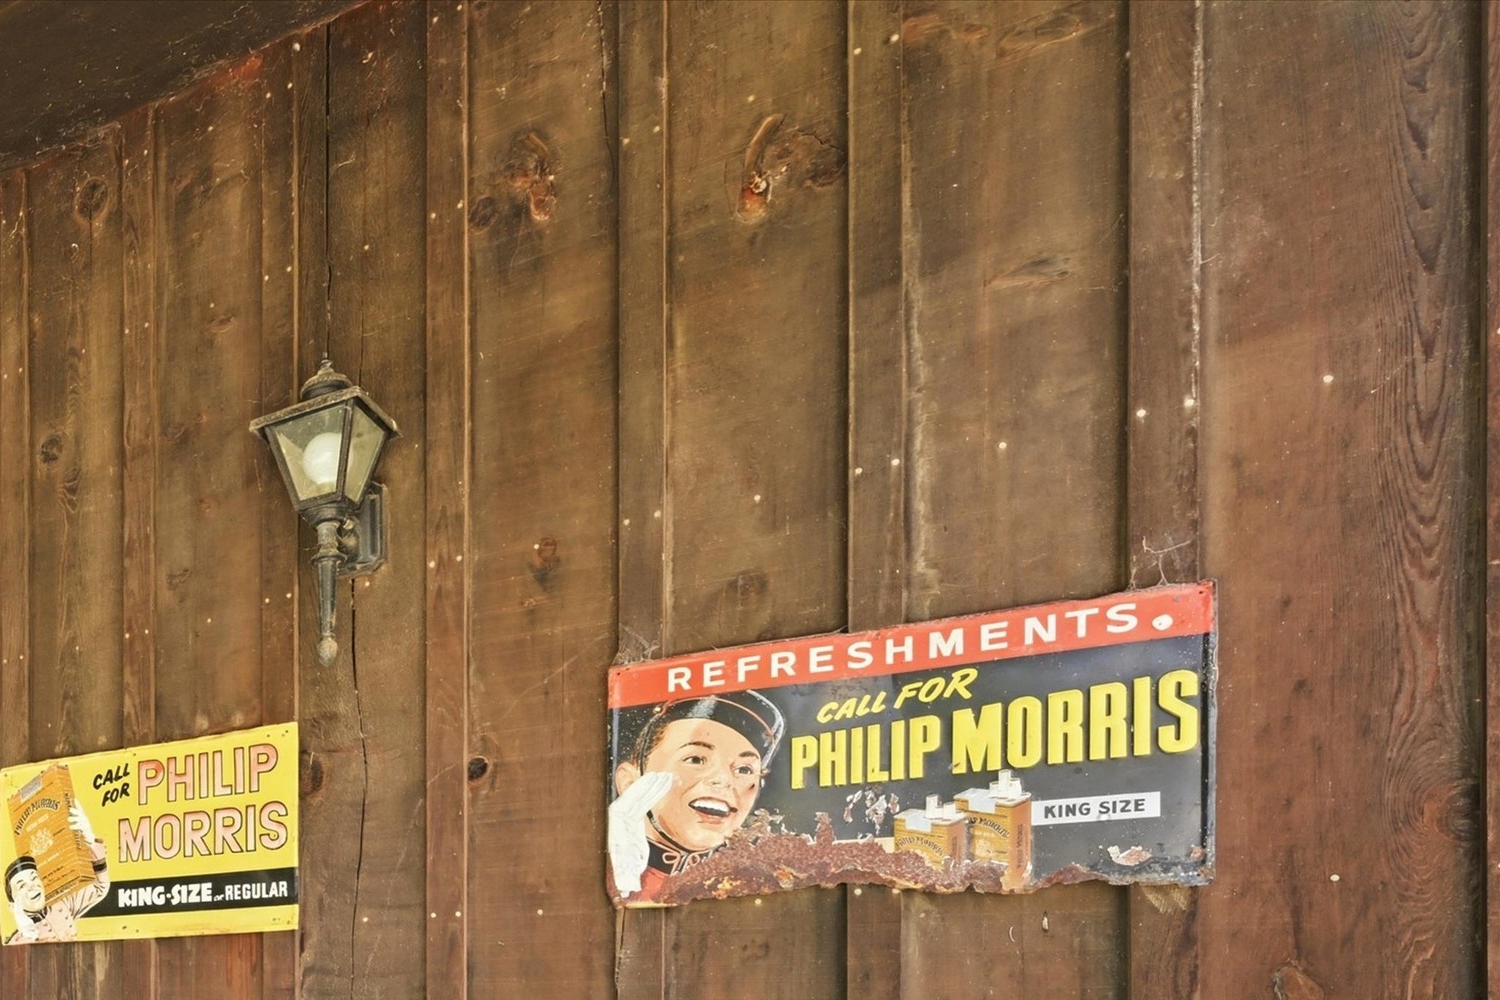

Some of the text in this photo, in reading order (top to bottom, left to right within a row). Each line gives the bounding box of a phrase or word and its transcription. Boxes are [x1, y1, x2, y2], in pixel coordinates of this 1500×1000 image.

[667, 603, 1173, 693] REFRESHMENTS.
[816, 667, 978, 724] CALL FOR
[791, 669, 1198, 790] PHILIP MORRIS
[93, 763, 131, 790] CALL
[102, 783, 130, 806] FOR
[137, 743, 278, 805] PHILIP
[118, 800, 288, 863] MORRIS
[1043, 798, 1146, 819] KING SIZE
[225, 881, 288, 901] REGULAR
